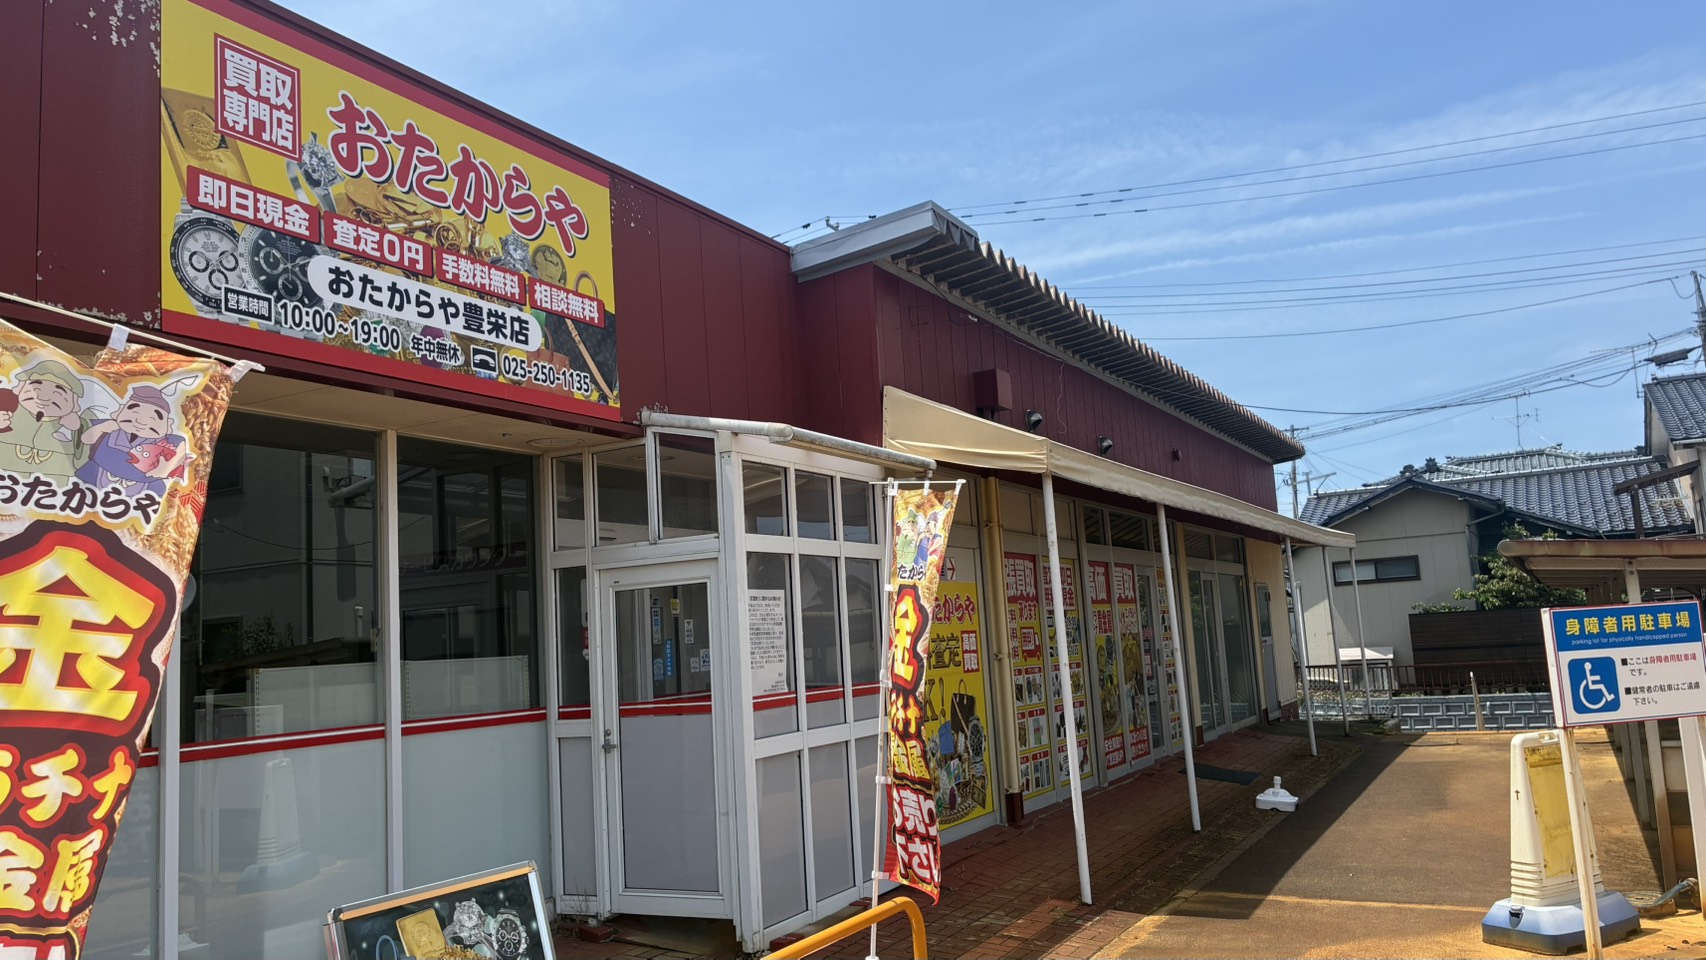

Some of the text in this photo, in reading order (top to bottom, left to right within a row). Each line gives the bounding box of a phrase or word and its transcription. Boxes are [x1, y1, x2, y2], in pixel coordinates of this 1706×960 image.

[224, 48, 293, 110] 買取
[223, 89, 294, 150] 専門店
[327, 91, 588, 256] おたからや
[198, 174, 311, 236] 即日現金
[442, 253, 520, 299] 手数料無料
[227, 292, 269, 316] 営業時間
[328, 265, 530, 346] おたからや豊栄店
[534, 282, 599, 323] 相談無料
[410, 335, 461, 363] 年中無休
[503, 355, 590, 393] 025-250-1135
[1114, 567, 1135, 600] 買取
[0, 545, 155, 721] 金
[962, 632, 977, 652] 高価
[1566, 611, 1691, 636] 身障者用駐車場
[1572, 638, 1592, 646] parking
[1609, 635, 1634, 643] physically
[1635, 632, 1670, 641] handicapped
[1671, 632, 1688, 640] person
[929, 633, 962, 670] 査定
[963, 653, 979, 672] 買取
[1629, 668, 1648, 677] です。
[1633, 697, 1658, 706] 下さい。
[890, 732, 931, 780] 金属
[0, 748, 132, 822] チナ
